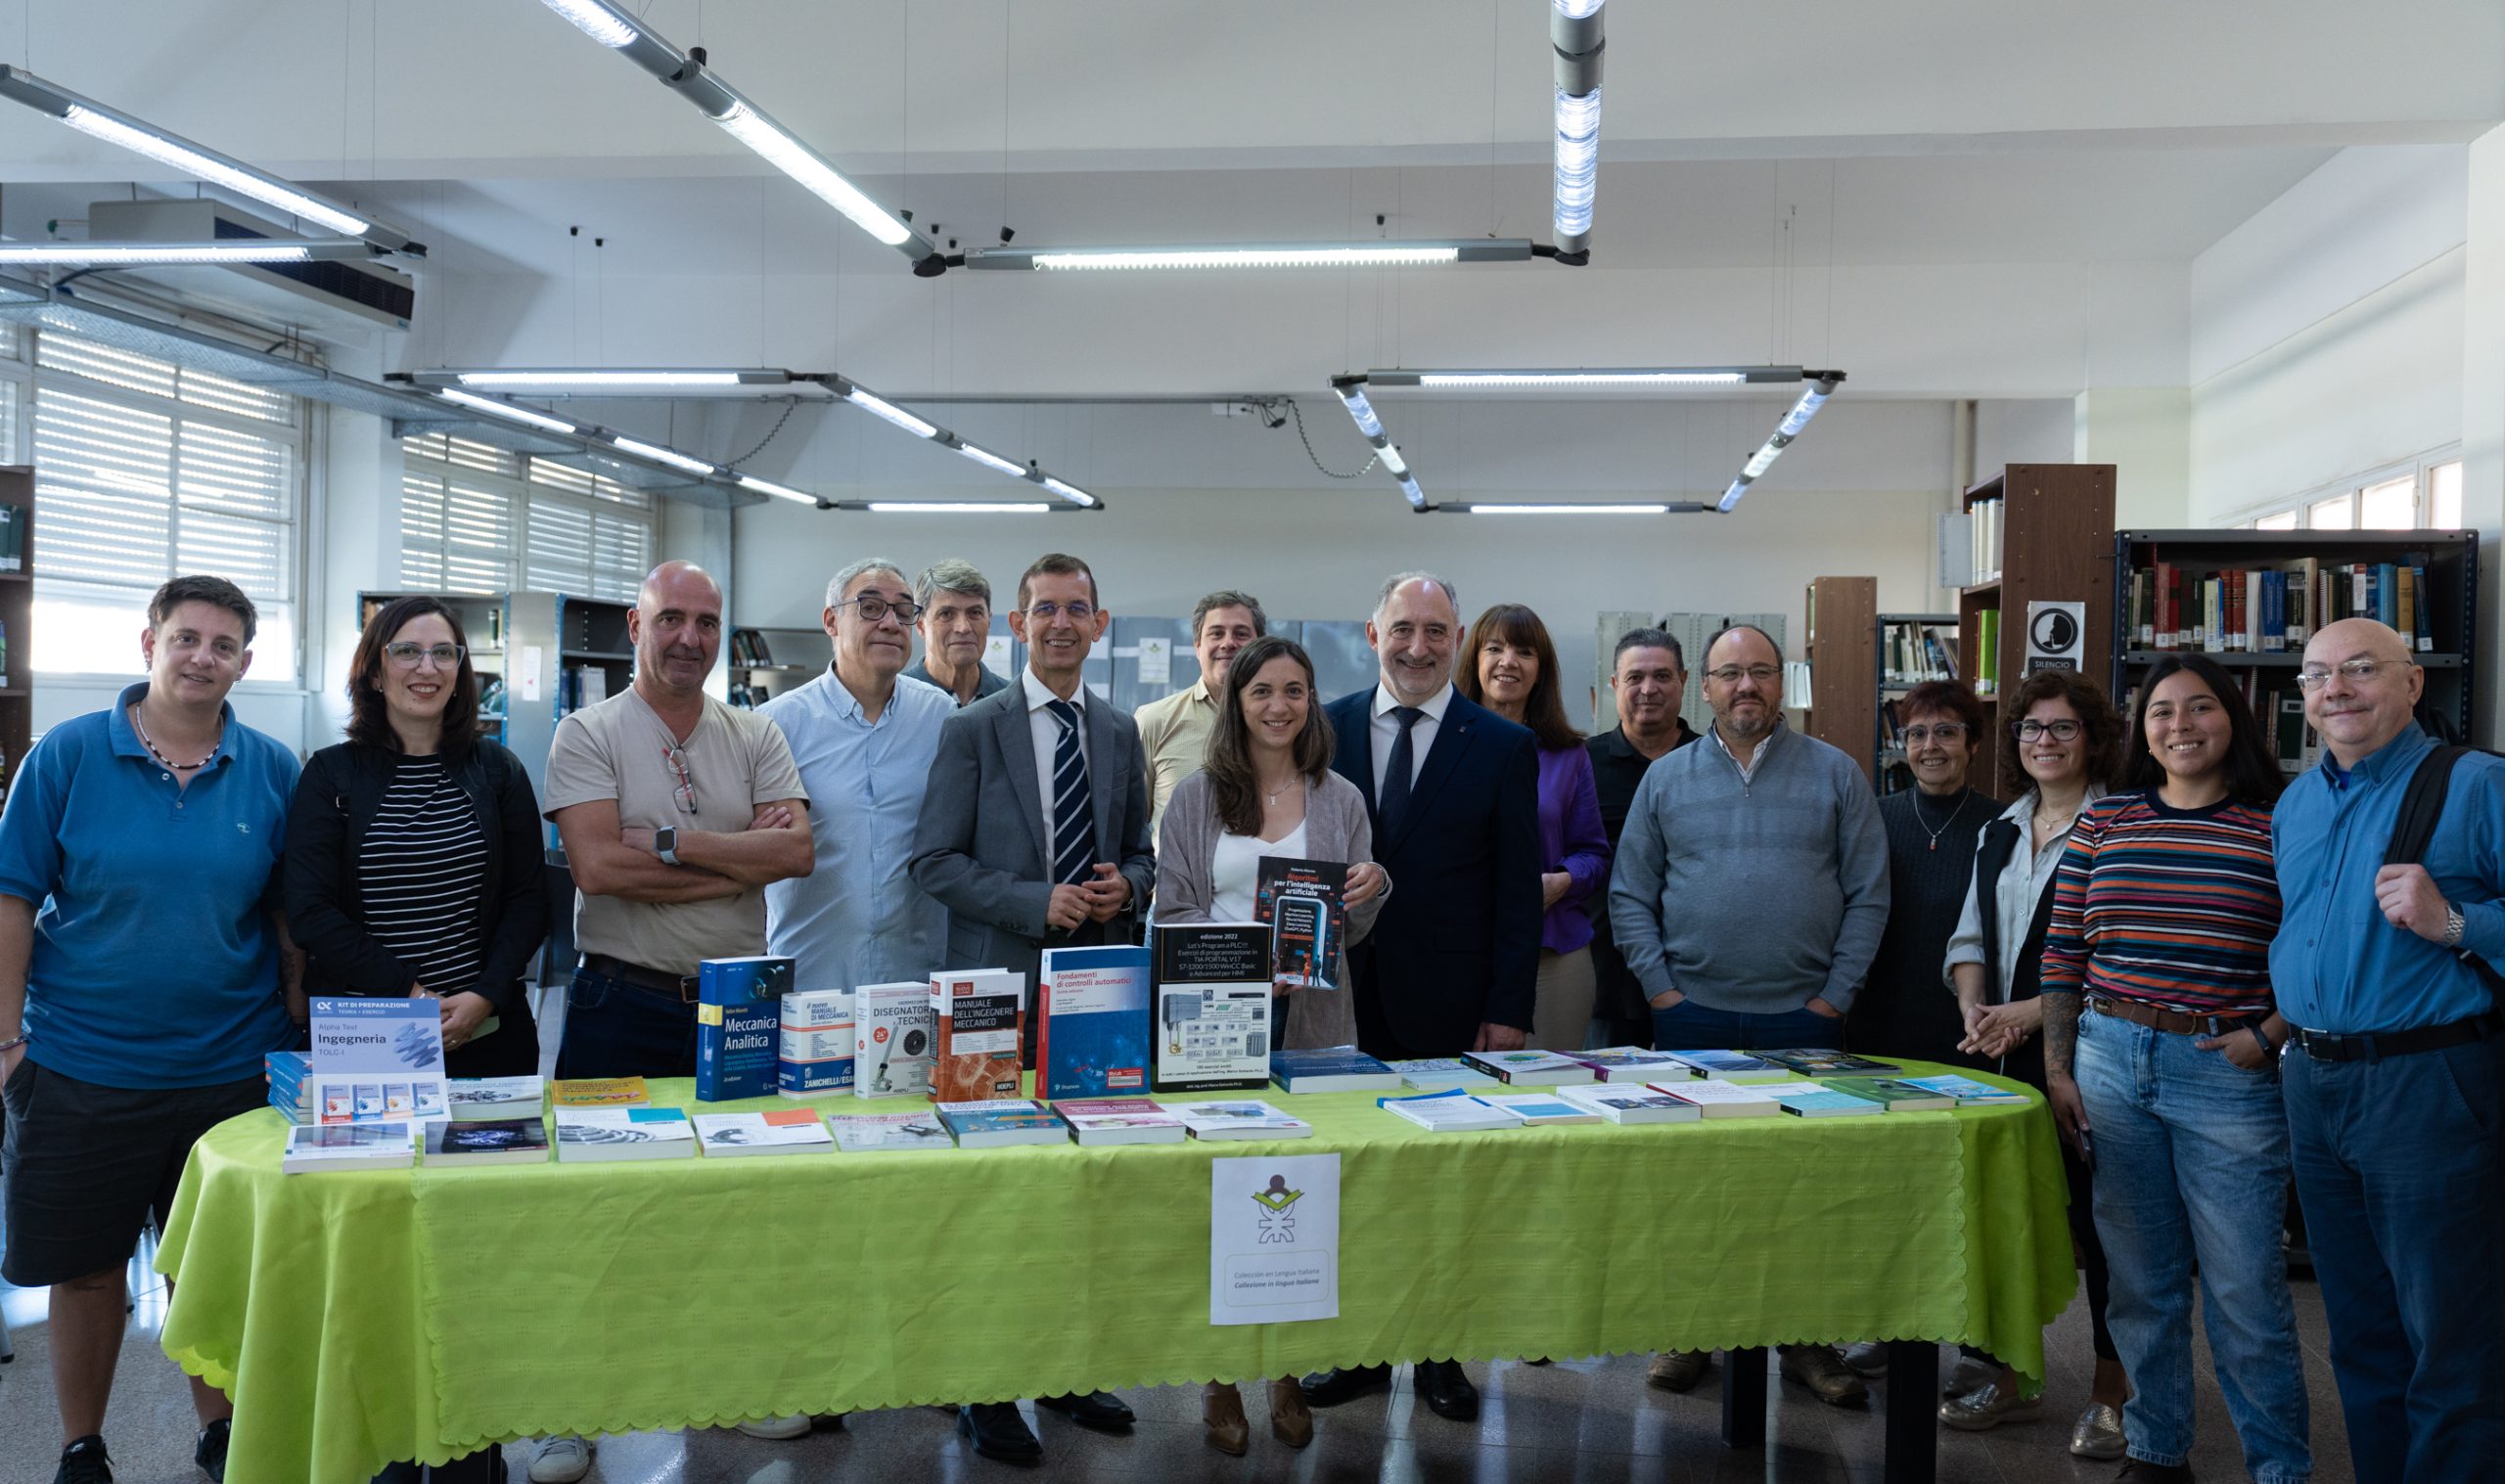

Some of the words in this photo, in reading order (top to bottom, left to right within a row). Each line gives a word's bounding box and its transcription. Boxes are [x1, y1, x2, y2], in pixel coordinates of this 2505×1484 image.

[2035, 660, 2070, 669] SILENCIO
[1287, 873, 1319, 882] Algoritmi
[1287, 880, 1331, 891] l'intelligenza
[1285, 888, 1318, 896] artificiale
[1057, 971, 1097, 980] Fondamenti
[1065, 979, 1093, 987] controlli
[1095, 977, 1132, 985] automatici
[955, 999, 992, 1008] MANUALE
[818, 1012, 849, 1020] MECCANICA
[873, 1005, 930, 1017] DISEGNATOR
[955, 1007, 1014, 1019] DELL'INGEGNERE
[726, 1016, 777, 1033] Meccanica
[898, 1016, 929, 1025] TECNIC
[954, 1018, 996, 1028] MECCANICO
[319, 1034, 386, 1045] Ingegneria
[724, 1034, 769, 1050] Analitica
[804, 1075, 854, 1088] ZANICHELLI/ESA
[997, 1082, 1014, 1090] HOEPLI
